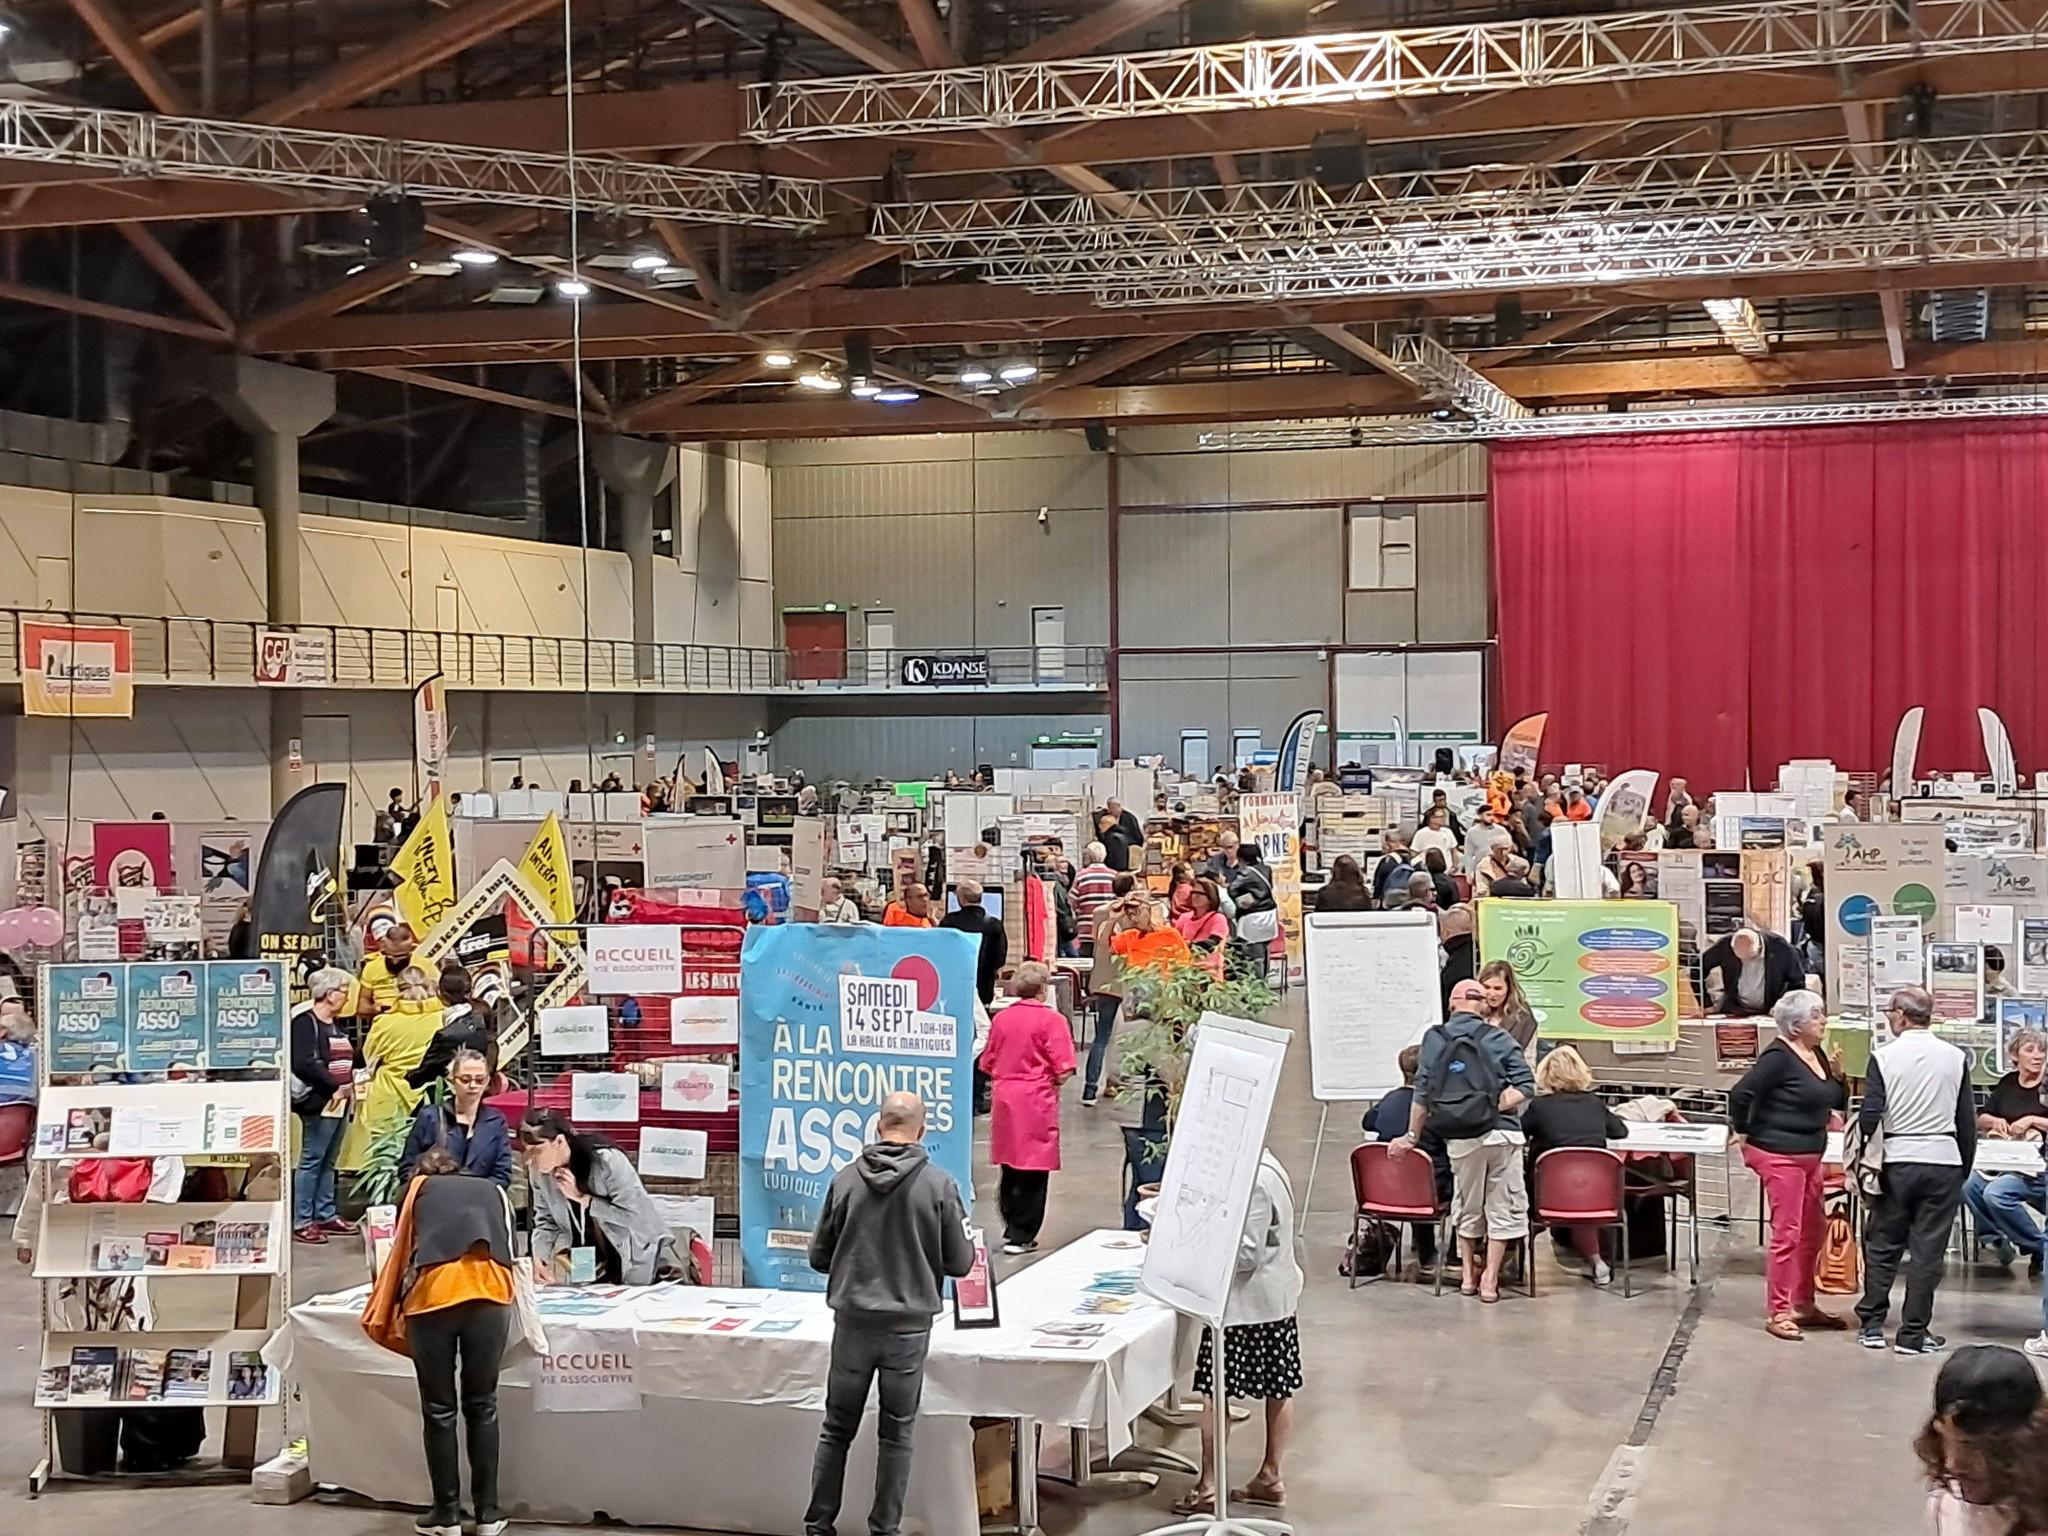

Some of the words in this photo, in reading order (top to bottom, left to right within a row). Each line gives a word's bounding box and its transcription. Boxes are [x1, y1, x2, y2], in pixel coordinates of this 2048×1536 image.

[931, 661, 988, 674] KDANSE
[260, 933, 280, 951] ON
[282, 933, 299, 951] SE
[595, 948, 674, 961] ACCUEIL
[612, 964, 675, 973] ASSOCIATIVE
[685, 971, 710, 989] LES
[847, 982, 908, 1008] SAMEDI
[57, 1012, 100, 1032] ASSO
[136, 1010, 180, 1030] ASSO
[215, 1008, 259, 1028] ASSO
[846, 1007, 866, 1032] 14
[871, 1008, 918, 1034] SEPT.
[773, 1016, 794, 1054] À
[799, 1023, 834, 1055] LA
[846, 1034, 857, 1047] LA
[859, 1035, 884, 1048] HALLE
[887, 1036, 898, 1049] DE
[900, 1036, 952, 1052] MARTIGUES
[772, 1057, 953, 1106] RENCONTRE
[764, 1172, 822, 1200] LUDIQUE
[541, 1353, 633, 1370] ACCUEIL
[540, 1375, 557, 1384] VIE
[560, 1374, 634, 1384] ASSOCIATIVE
